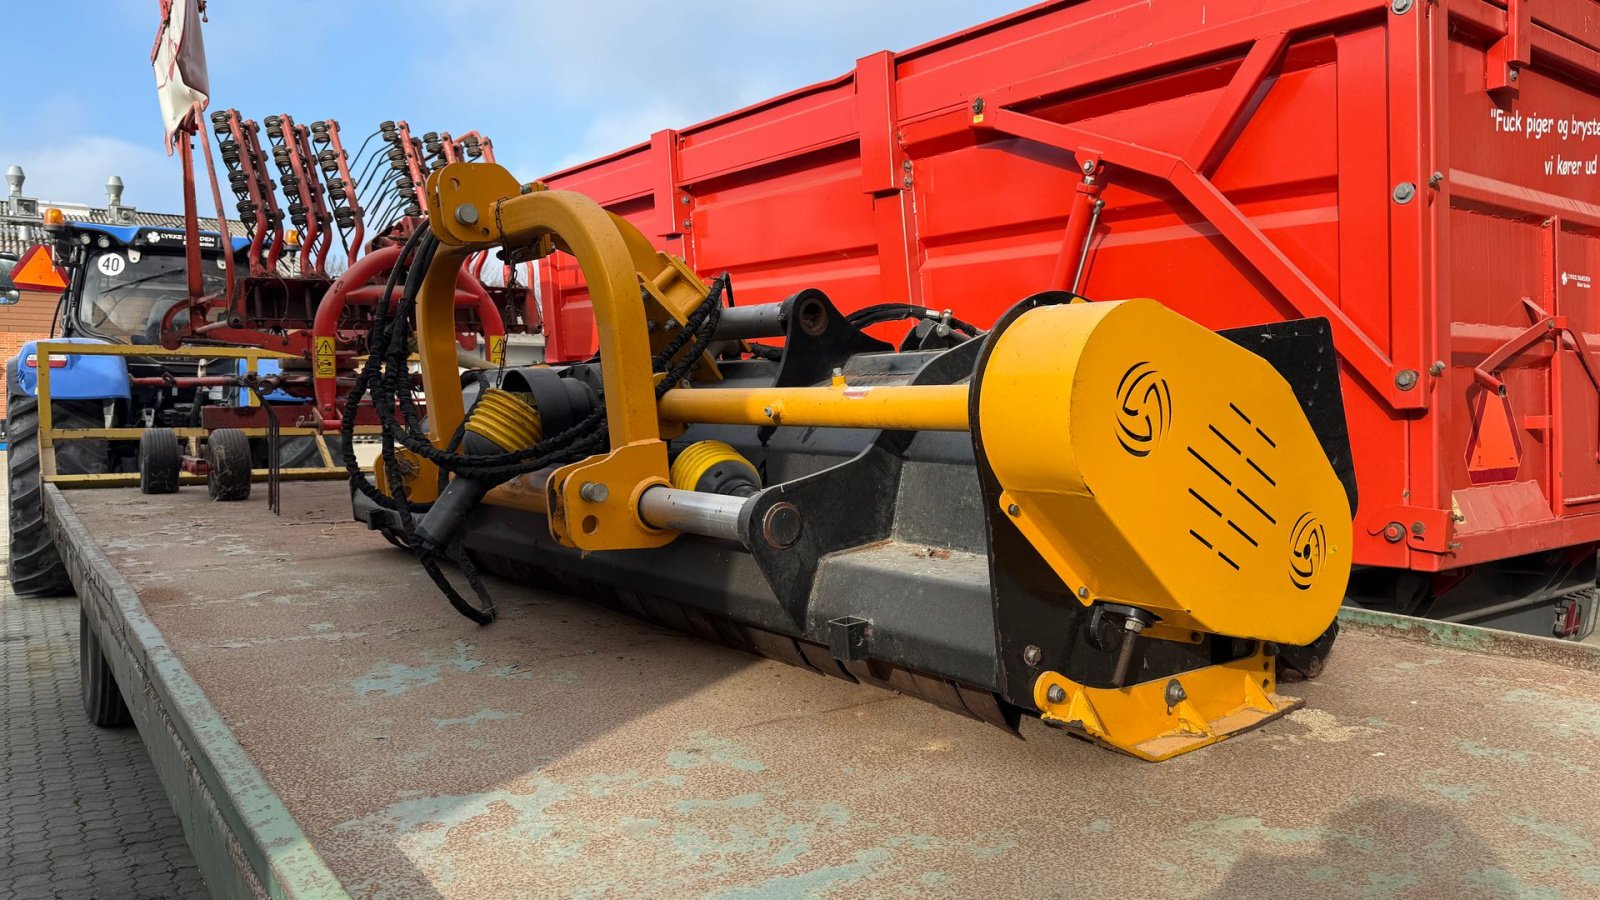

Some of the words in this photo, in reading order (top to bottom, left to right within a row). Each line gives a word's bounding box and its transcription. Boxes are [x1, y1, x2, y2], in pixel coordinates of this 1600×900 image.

[1490, 108, 1522, 132] "Fuck
[1526, 111, 1553, 139] piger
[1557, 119, 1569, 140] og
[1544, 155, 1554, 175] vi
[1557, 154, 1582, 175] kører
[1585, 154, 1598, 175] ud
[102, 256, 119, 272] 40
